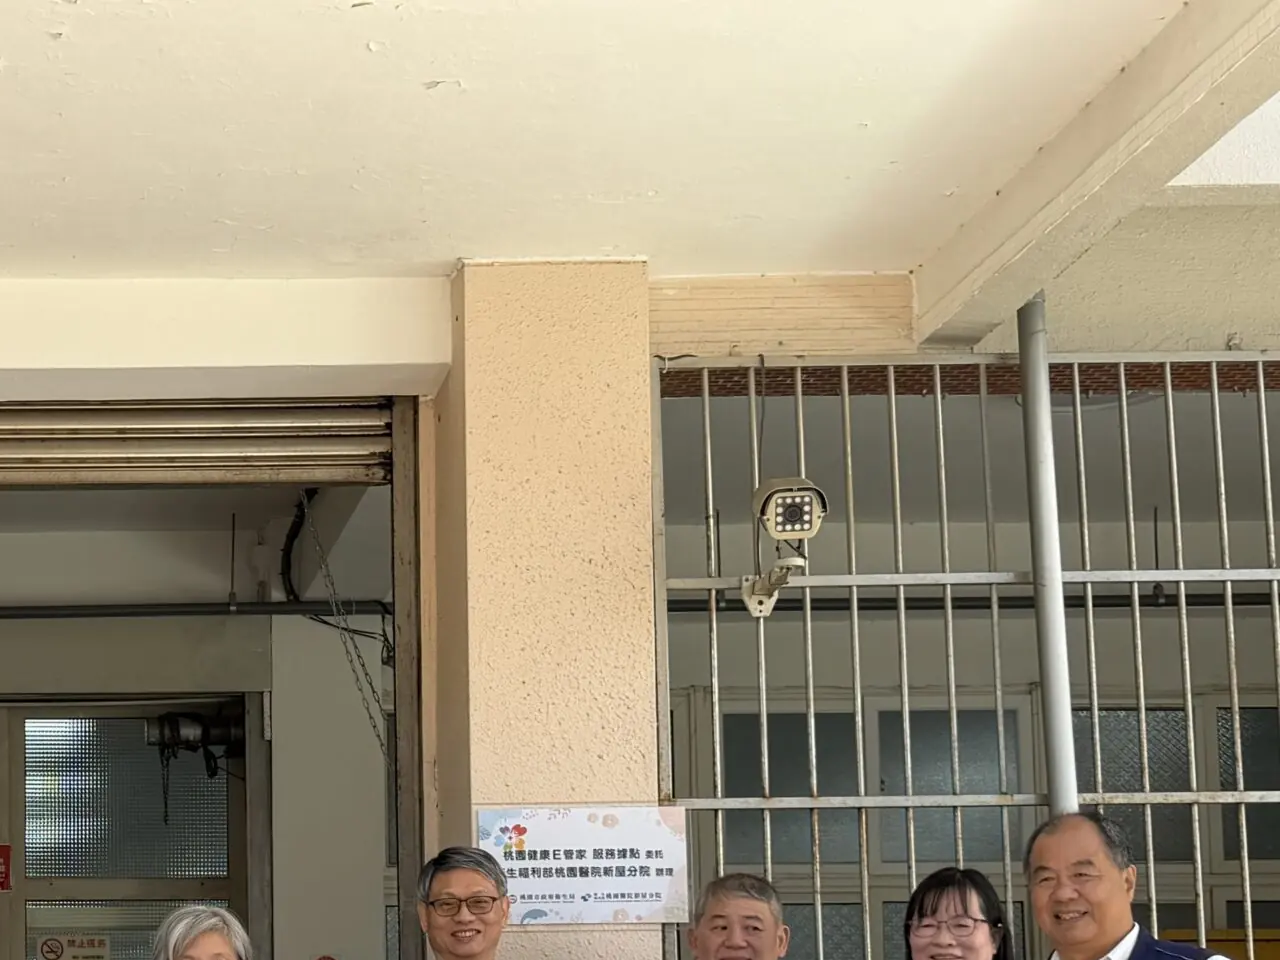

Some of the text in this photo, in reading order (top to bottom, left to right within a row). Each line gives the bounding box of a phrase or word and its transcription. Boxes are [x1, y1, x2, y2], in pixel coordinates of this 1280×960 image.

[502, 866, 651, 879] 生福利部桃園醫院新屋分院
